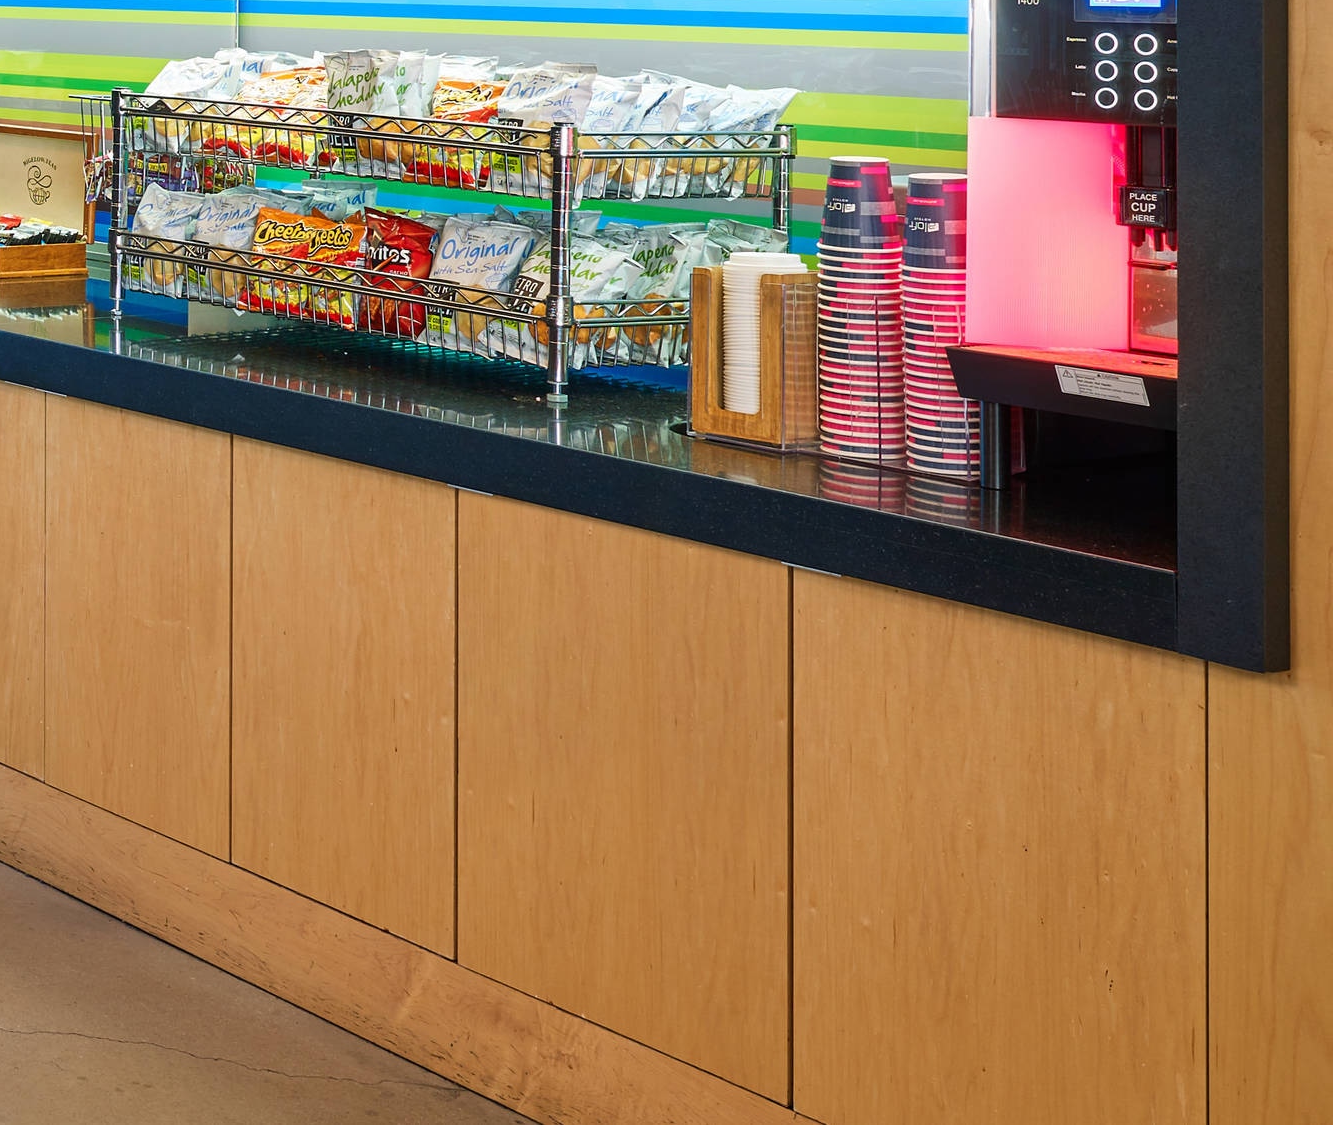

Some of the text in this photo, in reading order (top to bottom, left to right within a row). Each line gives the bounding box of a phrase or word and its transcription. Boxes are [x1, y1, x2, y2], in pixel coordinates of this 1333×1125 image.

[1129, 193, 1157, 201] PLACE
[1131, 202, 1156, 212] CUP
[441, 237, 521, 266] Original
[481, 261, 508, 273] Salt
